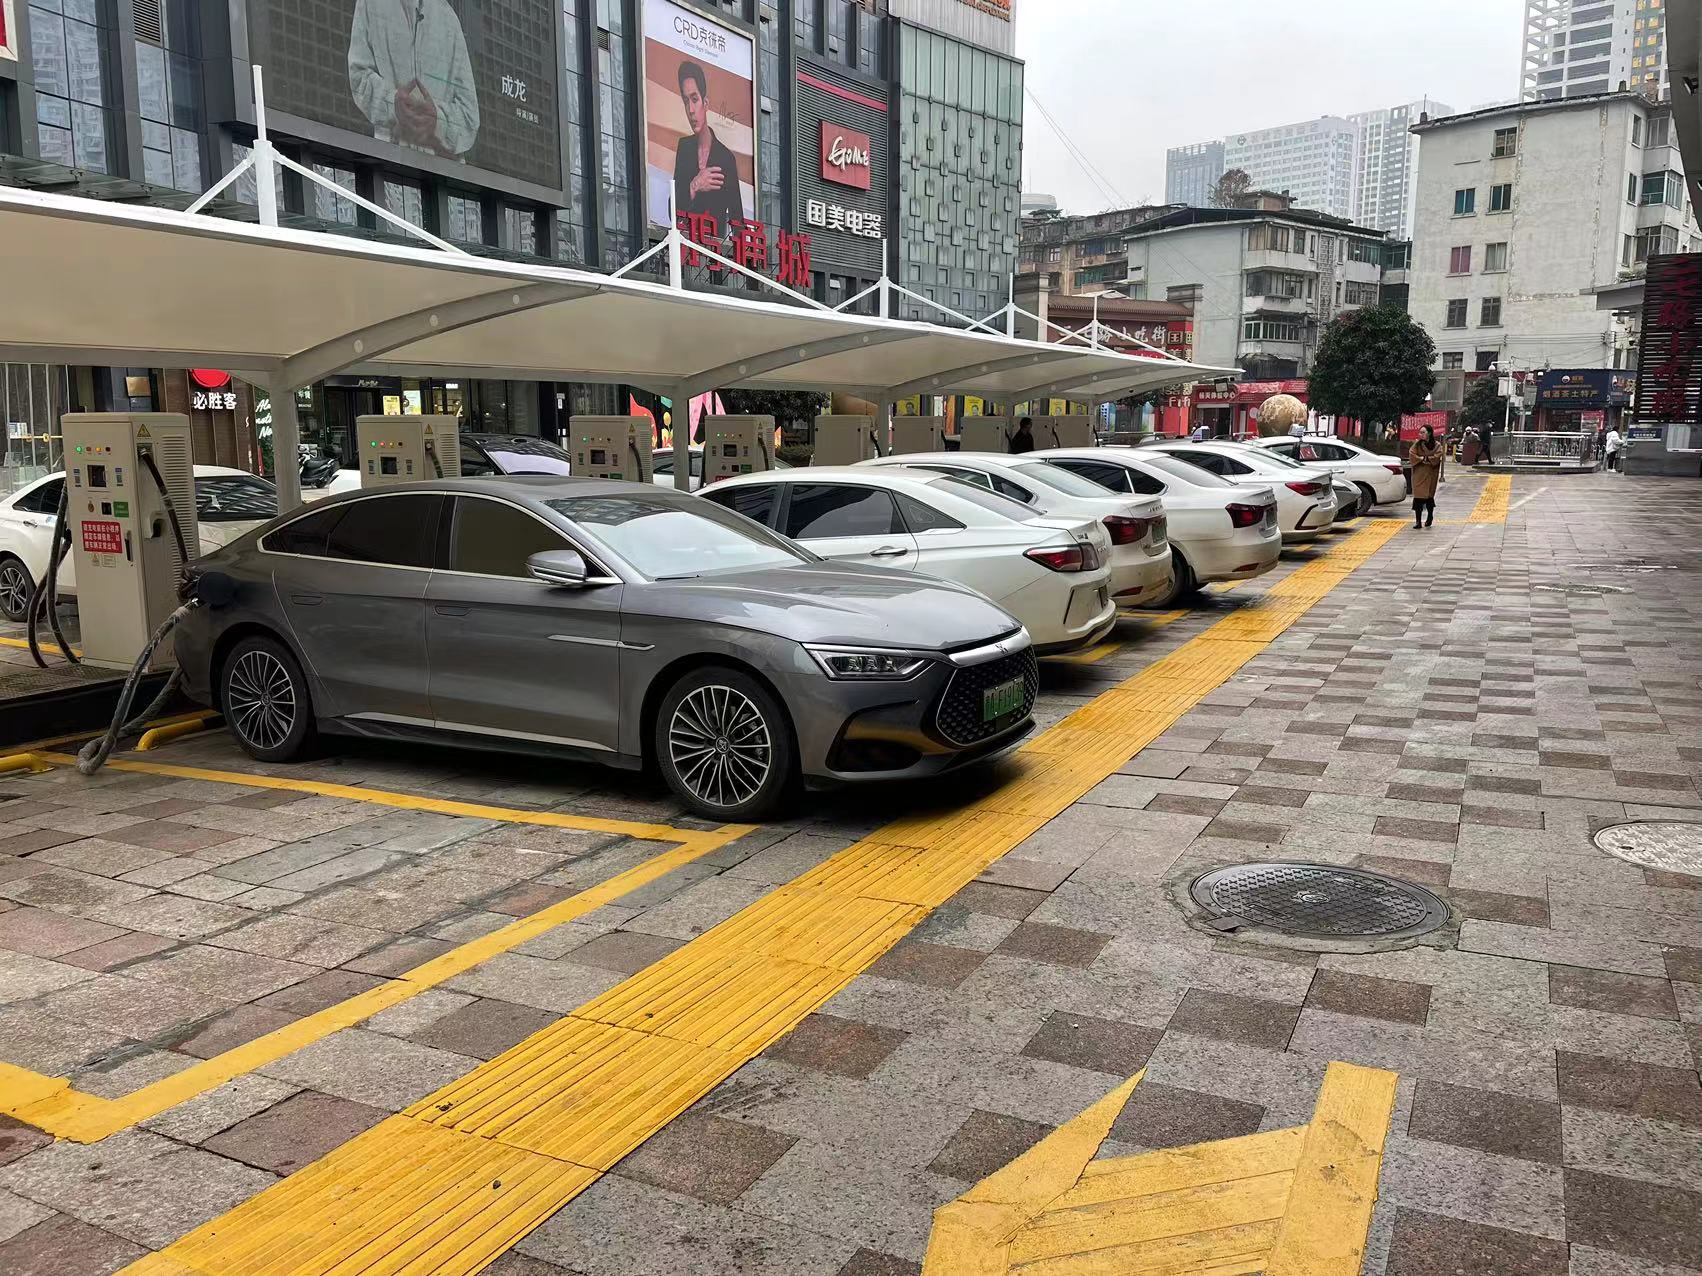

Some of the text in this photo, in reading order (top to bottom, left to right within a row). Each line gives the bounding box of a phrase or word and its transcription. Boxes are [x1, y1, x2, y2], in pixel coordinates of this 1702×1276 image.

[502, 74, 527, 102] 成龙
[806, 199, 881, 239] 国美电器
[192, 391, 238, 410] 必胜客
